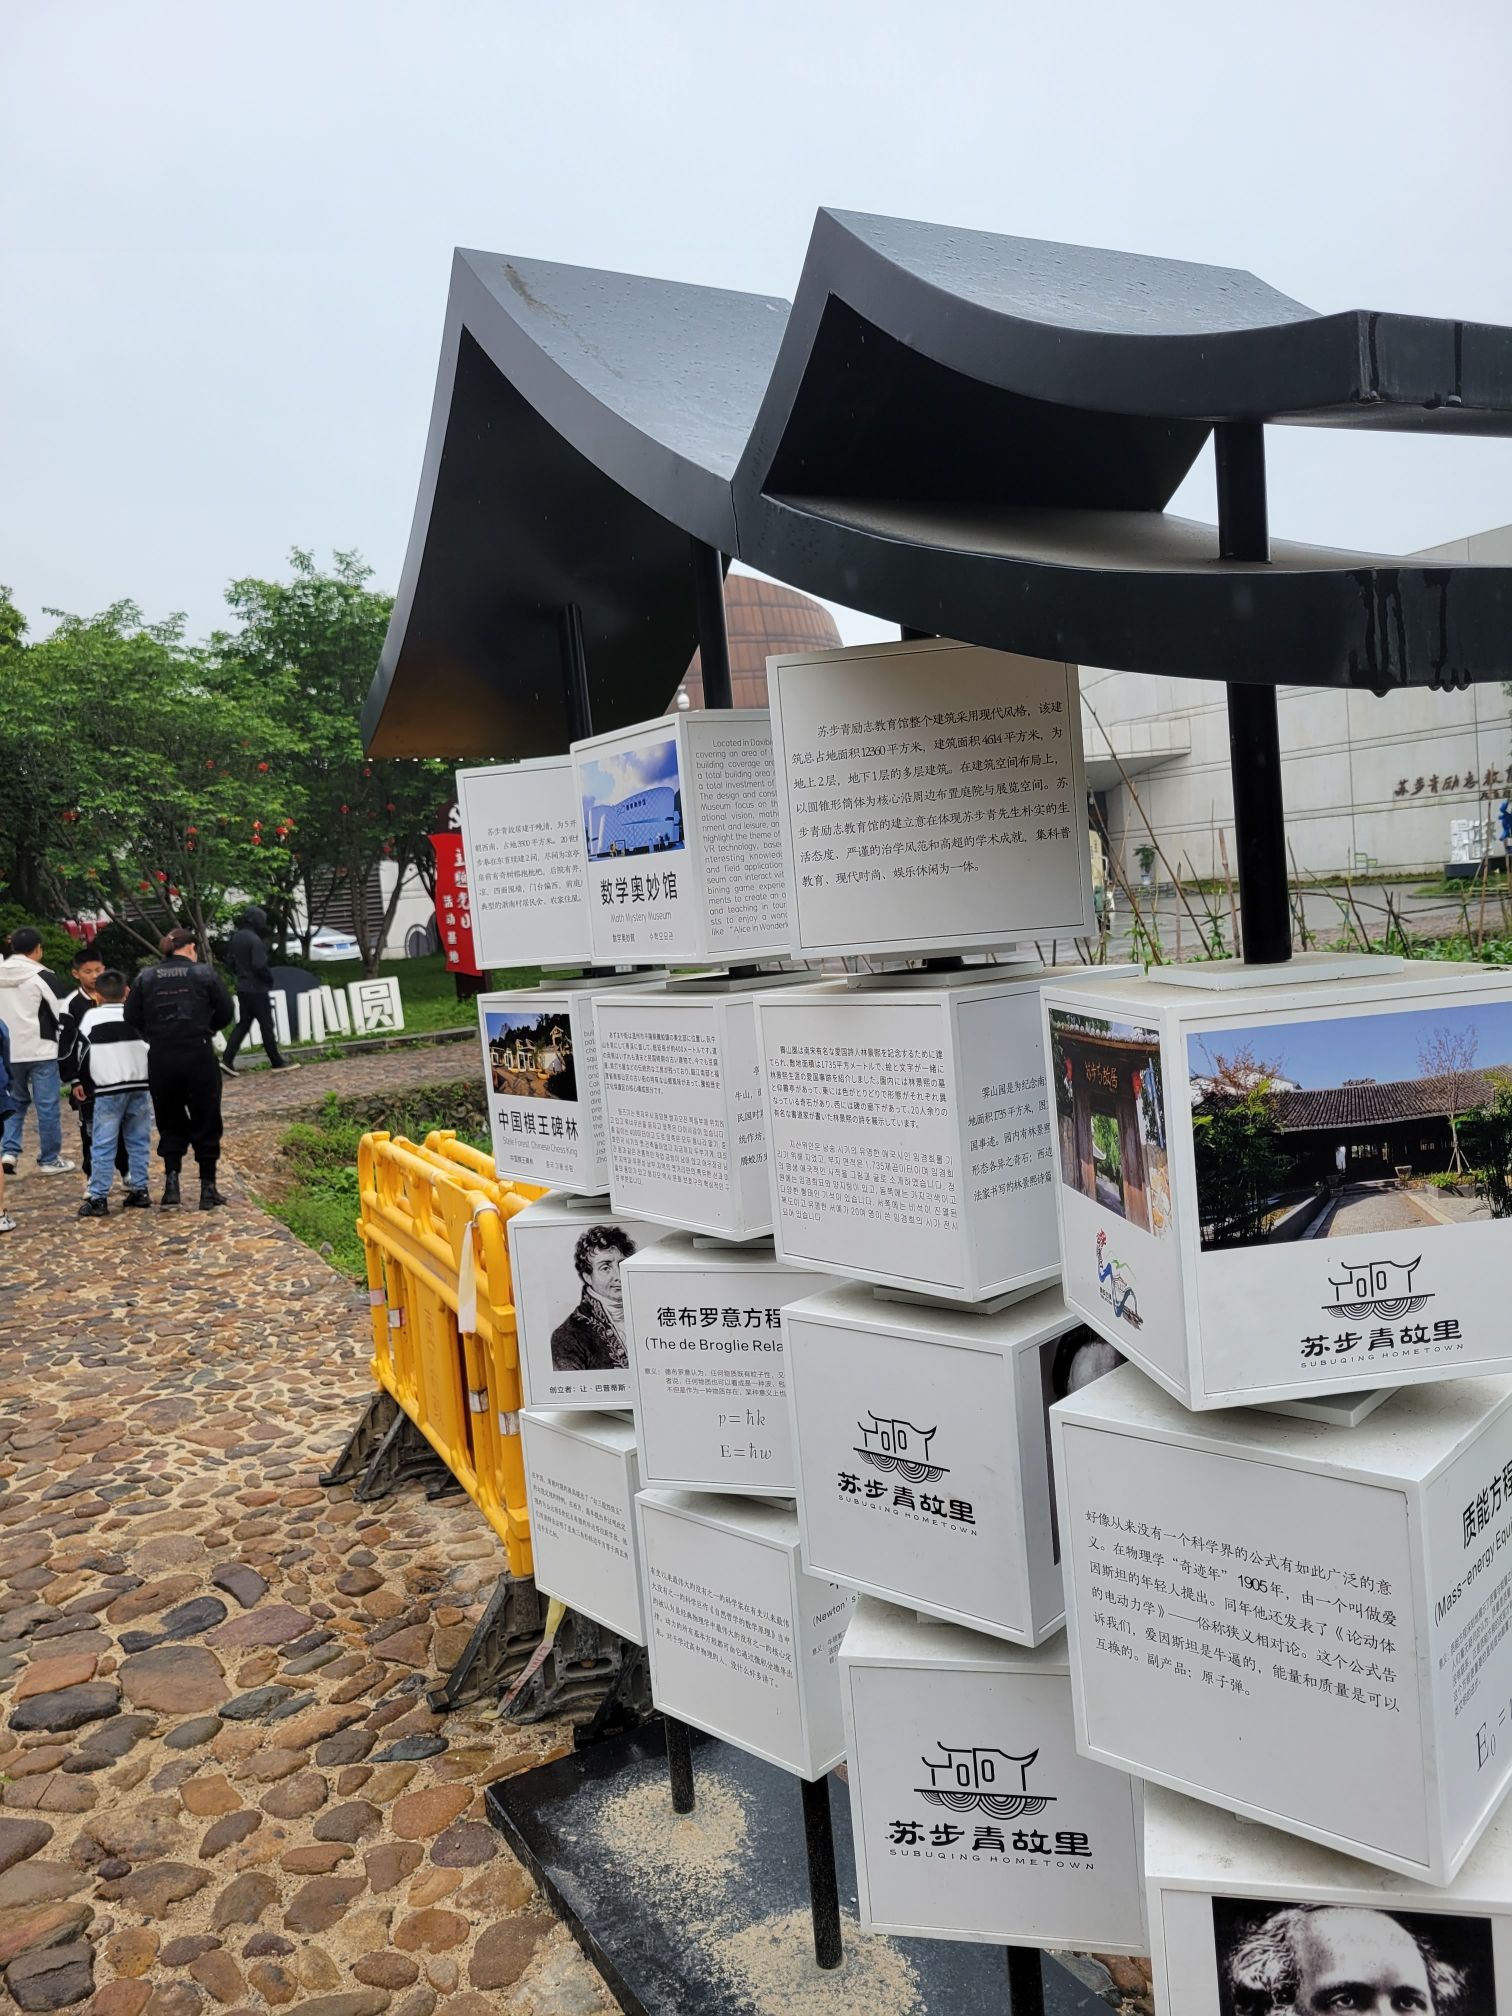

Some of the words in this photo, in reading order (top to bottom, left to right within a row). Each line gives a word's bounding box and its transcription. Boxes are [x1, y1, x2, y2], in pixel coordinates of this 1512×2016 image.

[696, 751, 726, 759] covering
[697, 761, 724, 769] building
[728, 760, 760, 768] coverage
[725, 771, 751, 779] building
[726, 780, 765, 788] investment
[717, 792, 739, 800] design
[749, 832, 771, 840] theme
[600, 871, 678, 906] 数学奥妙馆
[648, 911, 672, 921] Museum
[498, 1109, 579, 1141] 中国棋王碑林
[967, 1099, 1048, 1127] 地面积1735平方米，图
[657, 1306, 781, 1329] 德布罗意方程
[645, 1338, 676, 1351] (The
[679, 1339, 696, 1351] de
[699, 1339, 749, 1354] Broglie
[1301, 1319, 1463, 1358] 苏步青故里
[1300, 1354, 1375, 1368] SUBUQING
[1382, 1343, 1464, 1358] HOMETOWN
[837, 1471, 976, 1525] 苏步青故里
[1462, 1460, 1512, 1549] 质能方程
[838, 1494, 899, 1516] SUBUQING
[904, 1512, 978, 1536] HOMETOWN
[1085, 1509, 1392, 1596] 好像从来没有一个科学界的公式有如此广泛的意
[1435, 1541, 1494, 1627] (Mass-energy
[1089, 1560, 1397, 1655] 因斯坦的年轻人提出。同年他还发表了《论动体
[1095, 1637, 1251, 1697] 互换的。副产品：原子弹。
[886, 1820, 1093, 1857] 苏步青故里
[889, 1849, 981, 1862] SUBUQING
[990, 1855, 1095, 1870] HOMETOWN
